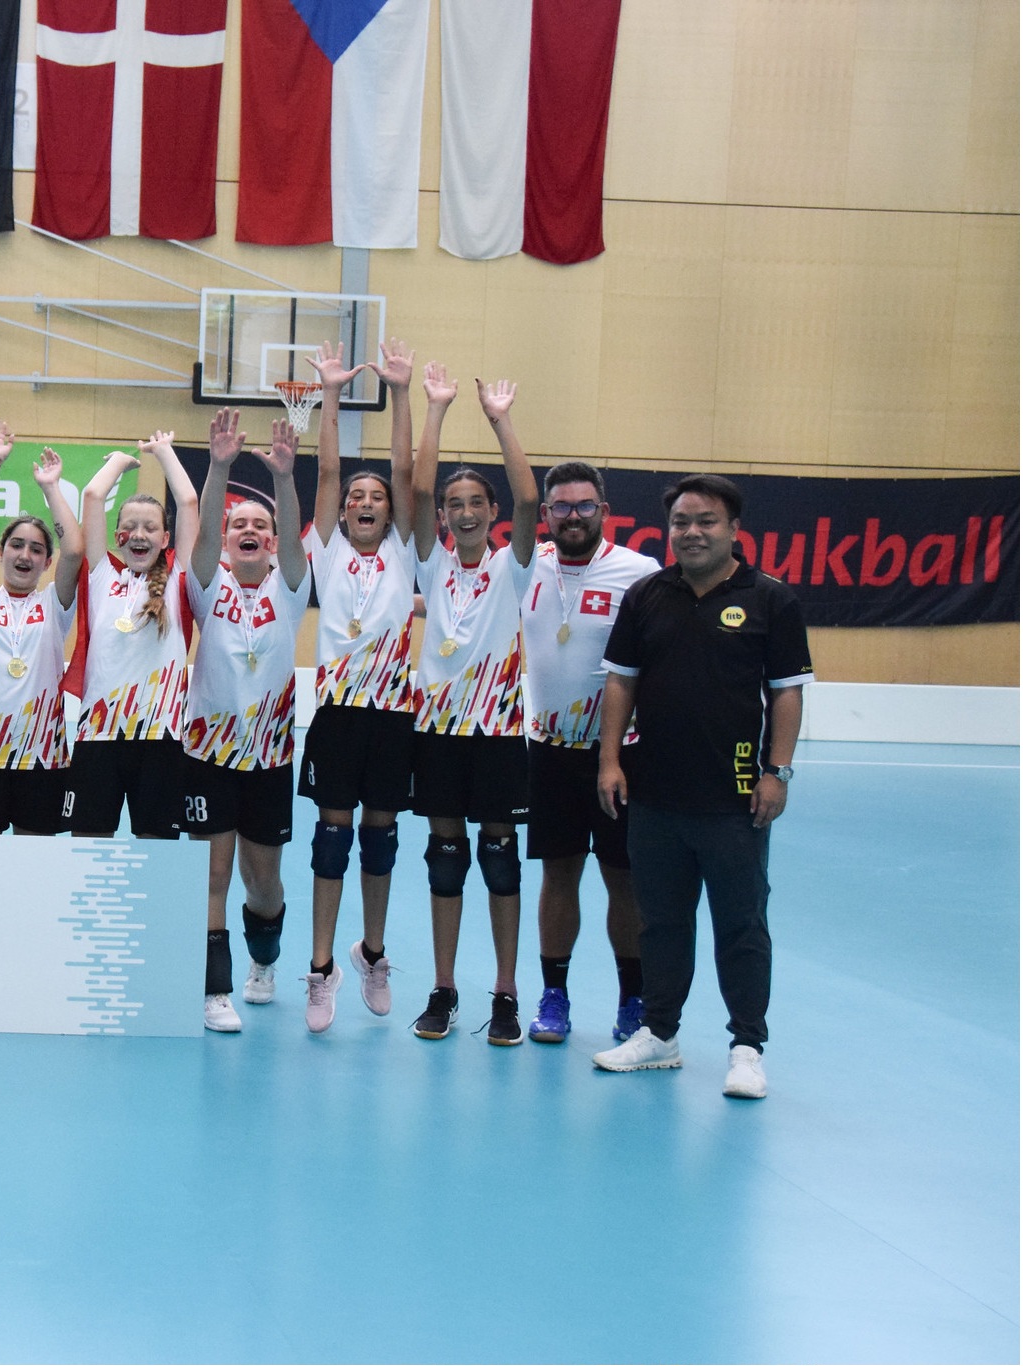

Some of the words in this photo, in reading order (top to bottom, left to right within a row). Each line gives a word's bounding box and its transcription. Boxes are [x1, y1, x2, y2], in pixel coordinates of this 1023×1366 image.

[726, 612, 742, 621] fitb
[737, 741, 753, 796] FITB
[185, 796, 208, 822] 28
